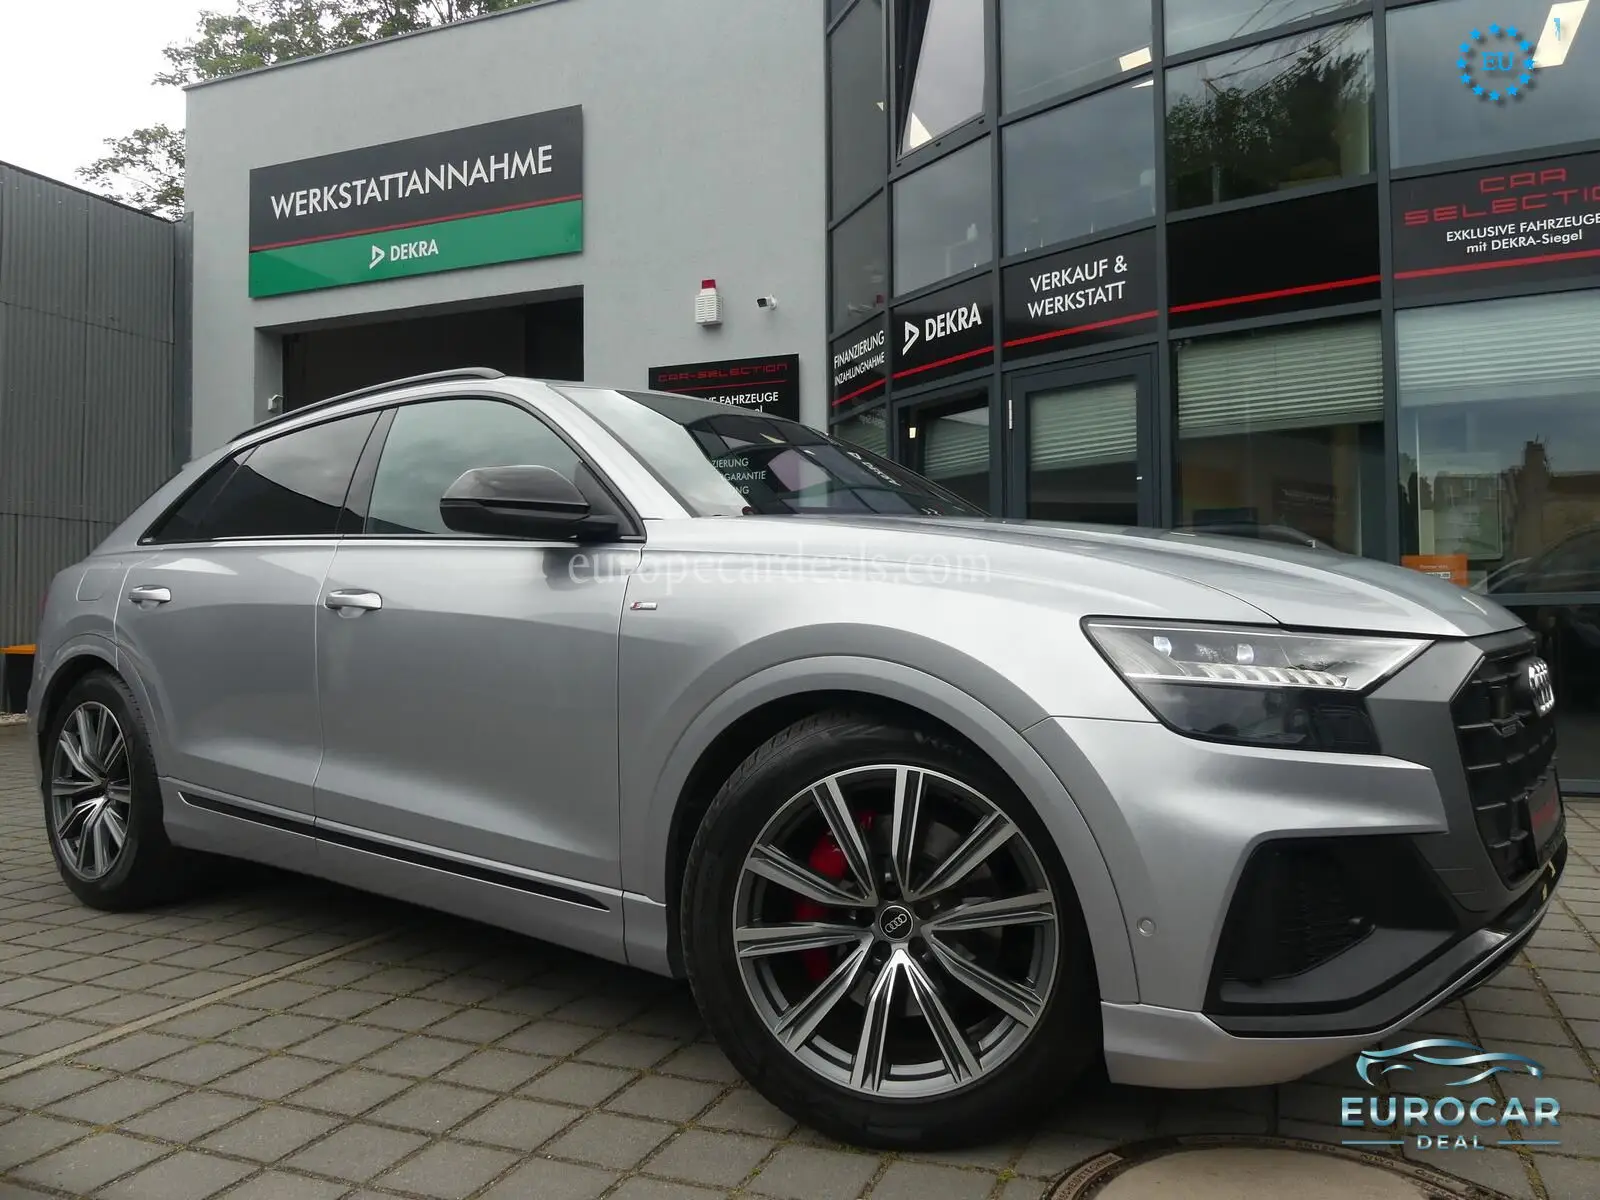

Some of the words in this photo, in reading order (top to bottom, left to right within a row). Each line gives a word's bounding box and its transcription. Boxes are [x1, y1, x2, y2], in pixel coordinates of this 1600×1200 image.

[270, 144, 553, 220] WERKSTATTANNAHME
[1480, 168, 1567, 195] CAR
[1446, 223, 1516, 243] EXKLUSIVE
[1520, 212, 1600, 234] FAHRZEUGE
[1466, 241, 1488, 254] mit
[1491, 229, 1583, 252] DEKRA-Siegel
[390, 238, 439, 263] DEKRA
[1029, 258, 1109, 293] VERKAUF
[1114, 254, 1128, 273] &
[1027, 281, 1127, 319] WERKSTATT
[925, 302, 983, 342] DEKRA
[834, 330, 885, 369] FINANZIERUNG
[657, 363, 788, 382] CAR-SELECTION
[834, 352, 885, 387] INZAHLUNGNAHME
[721, 391, 779, 405] FAHRZEUGE
